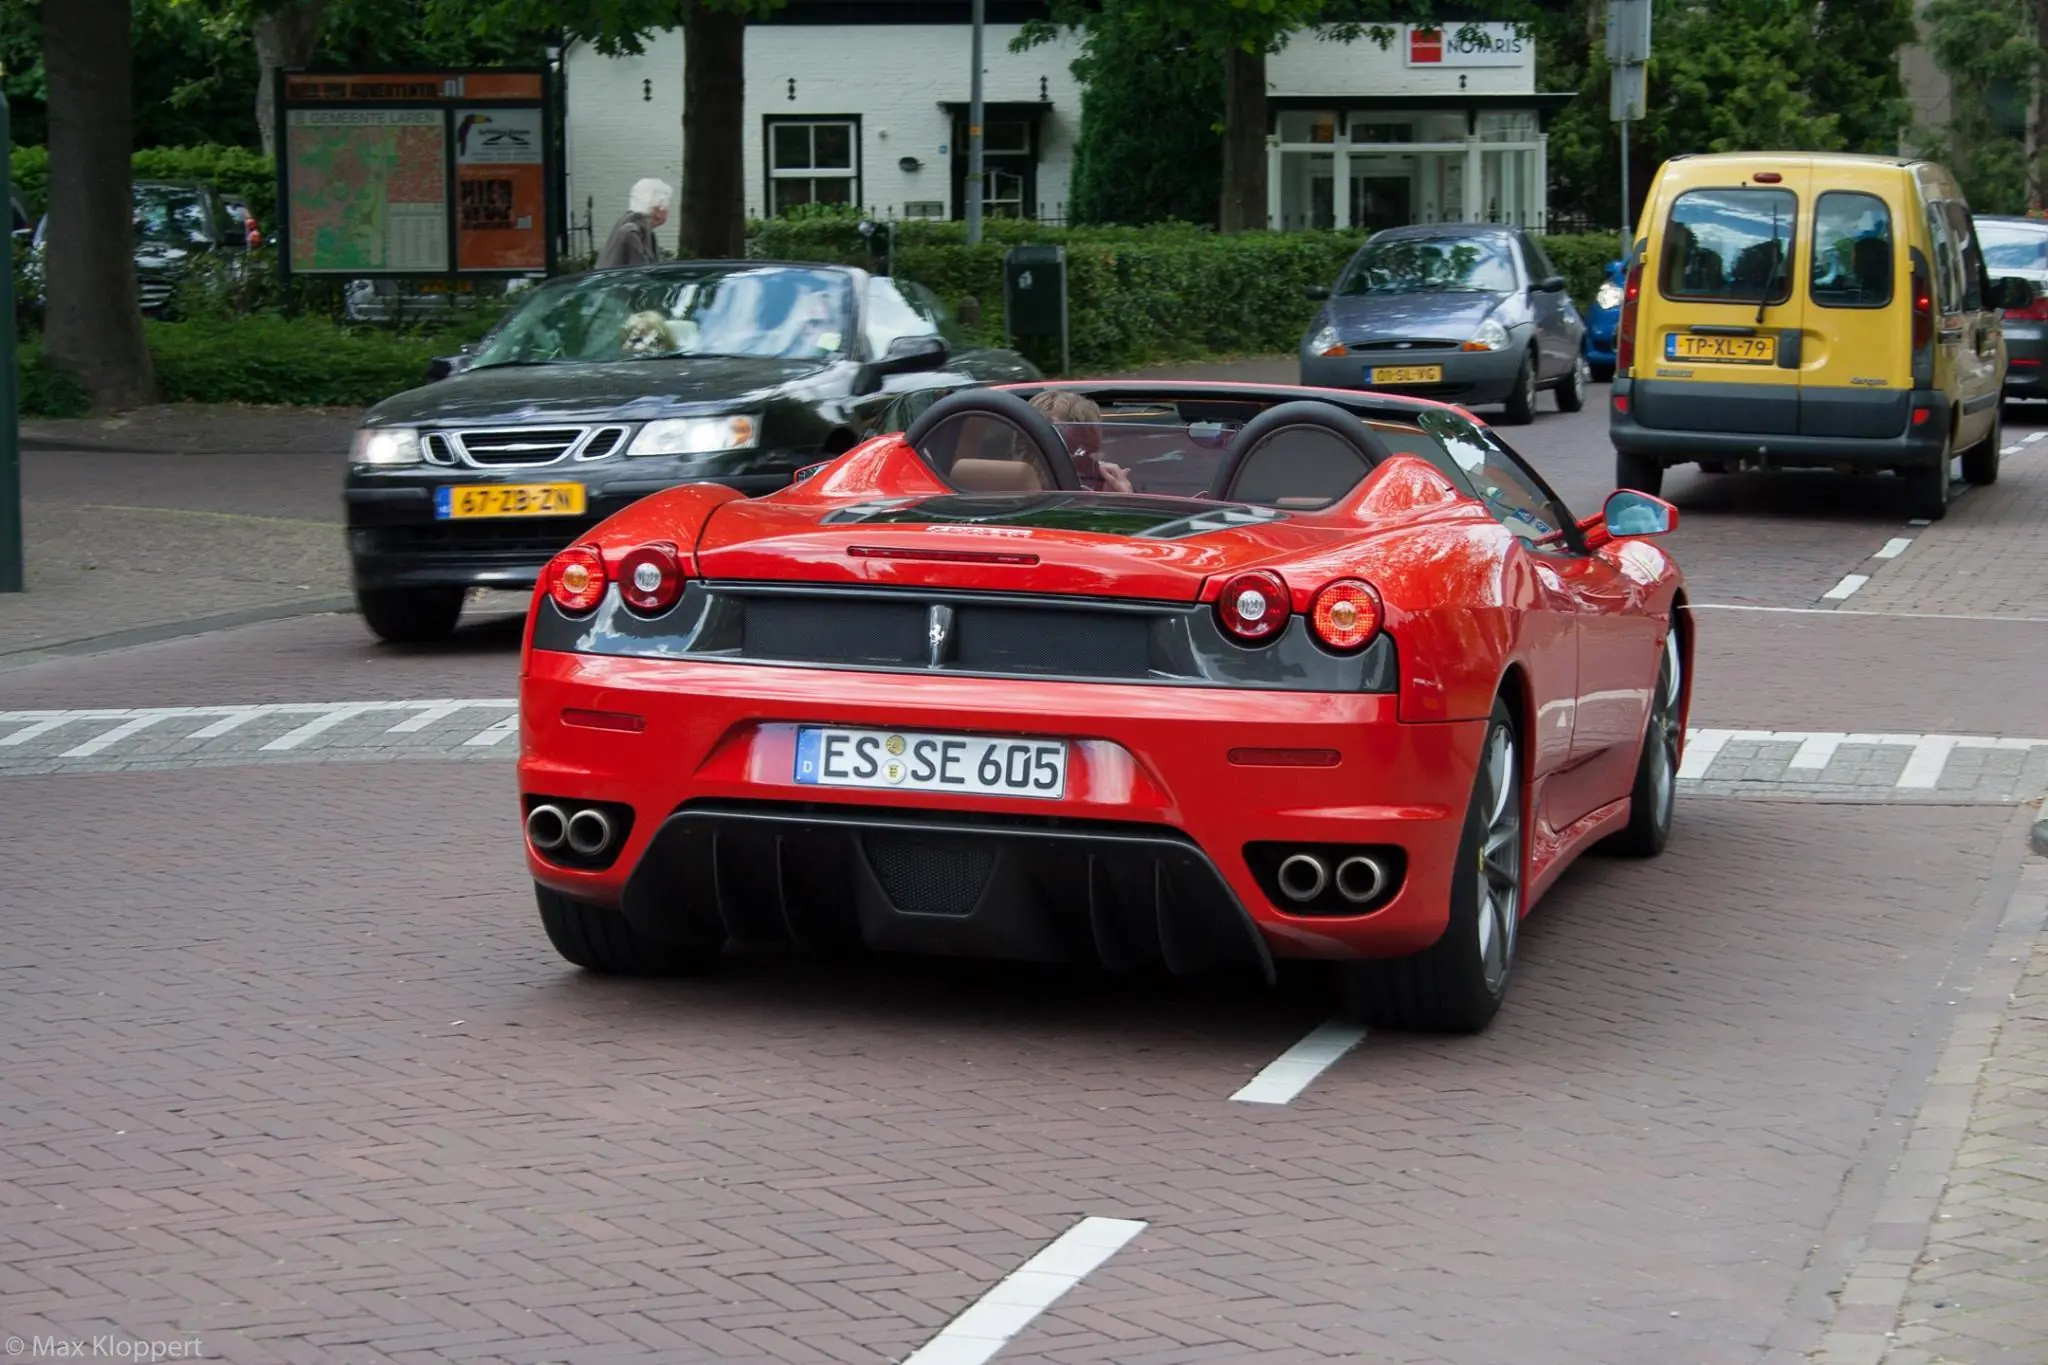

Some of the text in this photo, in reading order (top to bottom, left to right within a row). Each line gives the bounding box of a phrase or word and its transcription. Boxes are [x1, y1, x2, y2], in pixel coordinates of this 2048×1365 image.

[310, 112, 435, 124] GEMEENTE LAREN
[1684, 338, 1767, 357] TP-XL-79
[460, 488, 574, 514] 67-ZB-ZN
[802, 760, 812, 774] D
[823, 735, 1061, 790] ES SE 605
